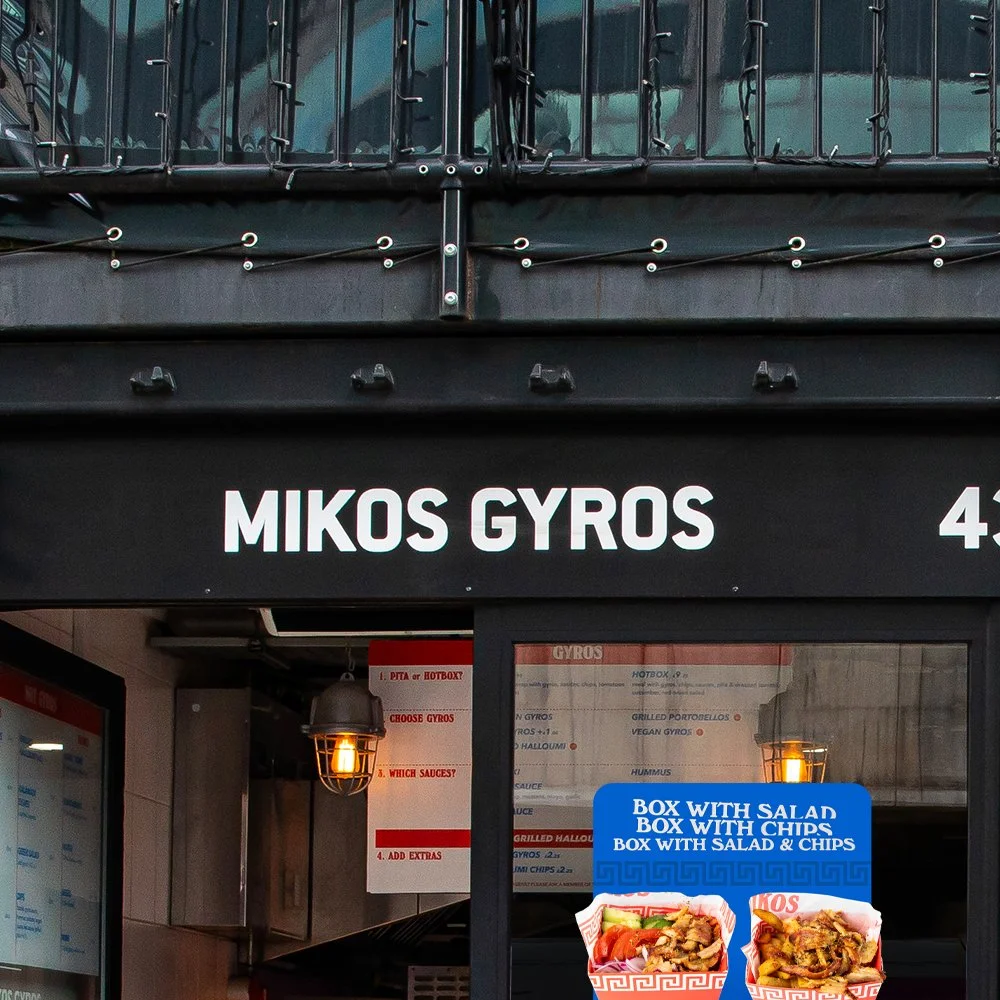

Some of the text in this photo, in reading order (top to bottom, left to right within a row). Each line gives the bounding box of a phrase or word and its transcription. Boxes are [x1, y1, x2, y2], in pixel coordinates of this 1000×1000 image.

[224, 485, 715, 552] MIKOS GYROS
[552, 645, 603, 660] GYROS
[390, 672, 409, 680] PITA
[424, 671, 464, 680] HOTBOX?
[389, 714, 455, 723] CHOOSE GYROS
[631, 728, 692, 736] VEGAN GYROS
[389, 769, 416, 778] WHICH
[420, 769, 457, 778] SAUCES?
[633, 799, 837, 820] BOX WITH SALAD
[636, 816, 833, 836] BOX WITH CHIPS
[513, 835, 594, 843] GRILLED HALLOU
[613, 837, 856, 851] BOX WITH SALAD & CHIPS
[388, 852, 406, 861] ADD
[409, 852, 443, 861] EXTRAS
[512, 851, 541, 859] GYROS
